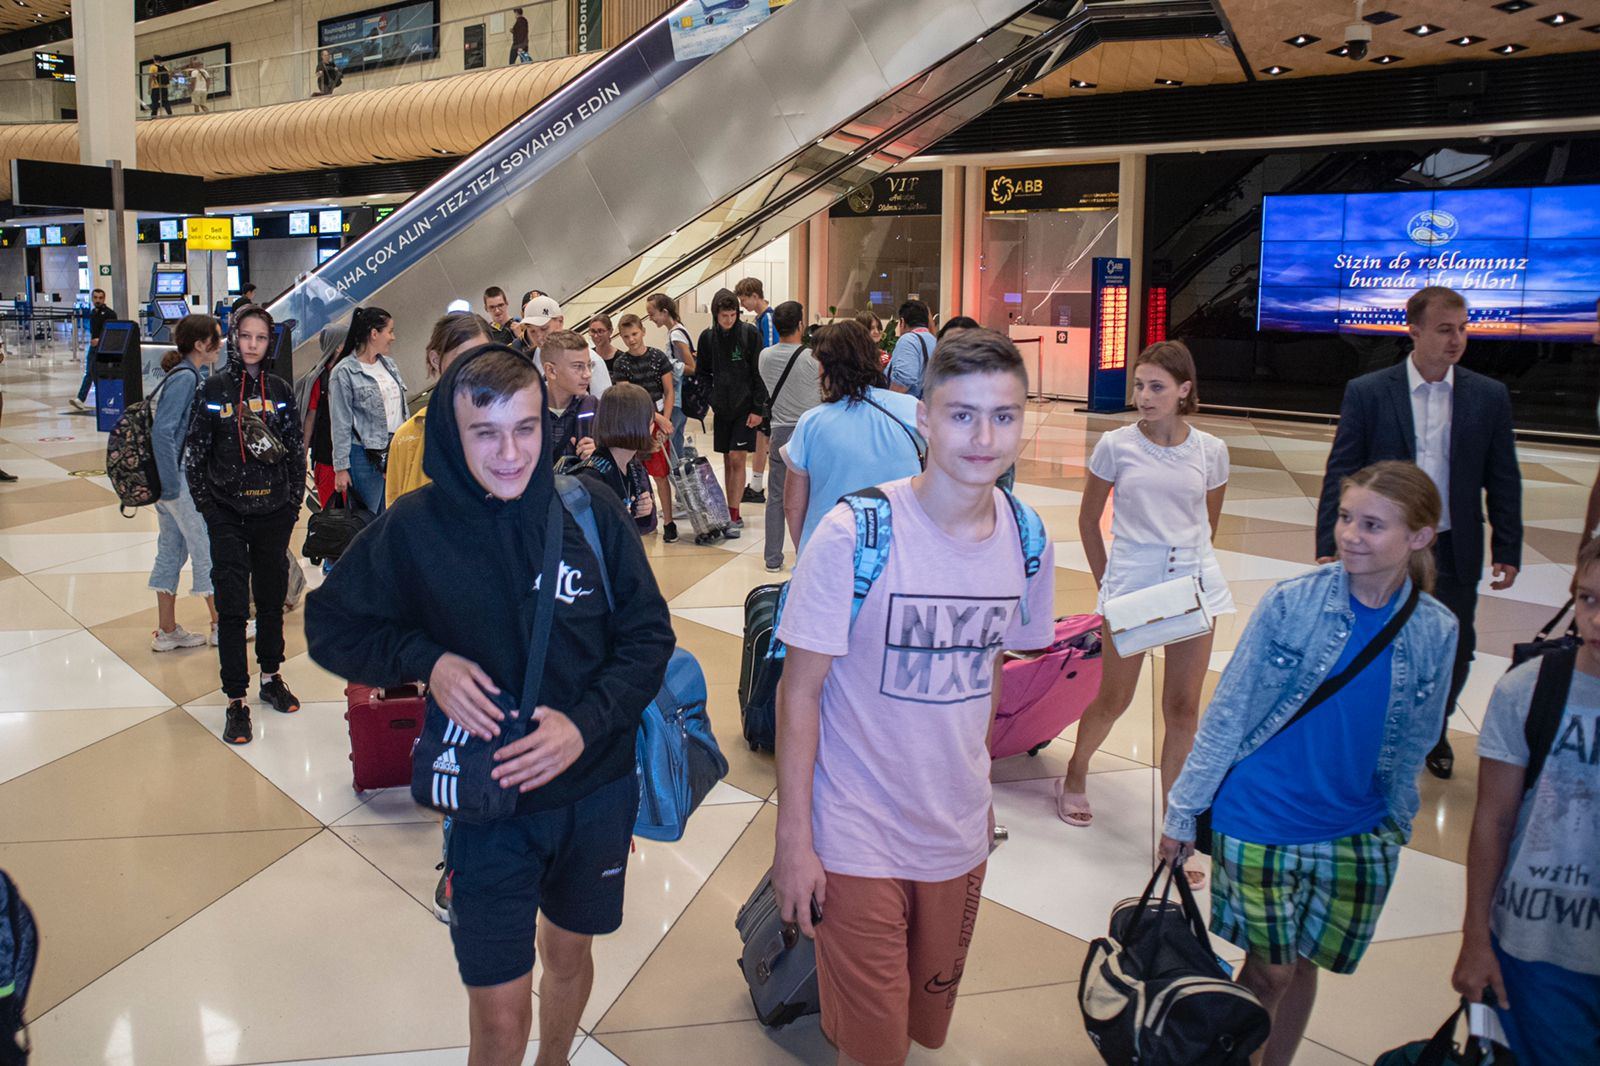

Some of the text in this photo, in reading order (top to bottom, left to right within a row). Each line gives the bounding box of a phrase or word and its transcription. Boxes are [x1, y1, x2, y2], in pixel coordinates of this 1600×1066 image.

[324, 266, 367, 301] DAHA
[366, 242, 397, 273] ÇOX
[501, 113, 575, 175] SƏYAHƏT
[577, 82, 621, 120] EDİN
[1015, 179, 1043, 193] ABB
[342, 223, 350, 232] 19
[1333, 251, 1529, 270] Sizin də reklamınız
[1349, 270, 1417, 288] burada
[1461, 270, 1518, 289] bilər!
[432, 760, 460, 775] adidas
[1528, 864, 1589, 886] with
[958, 873, 981, 947] NIKE
